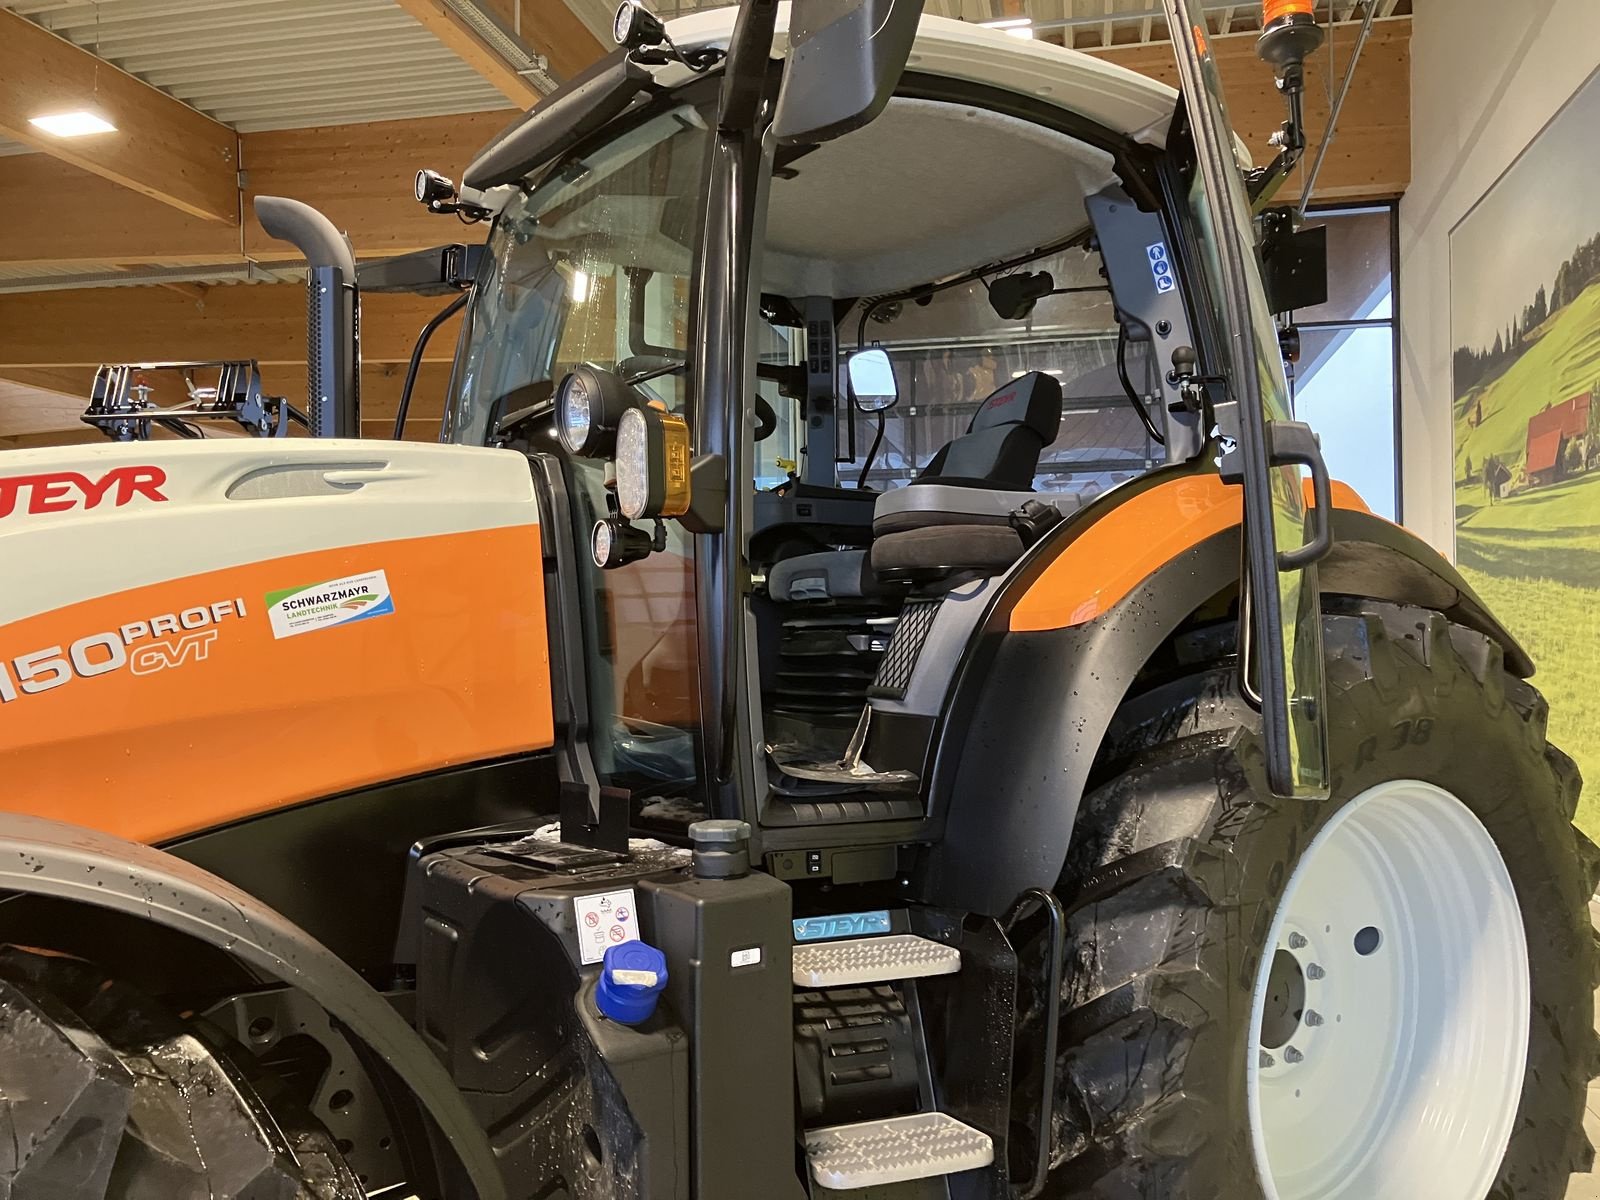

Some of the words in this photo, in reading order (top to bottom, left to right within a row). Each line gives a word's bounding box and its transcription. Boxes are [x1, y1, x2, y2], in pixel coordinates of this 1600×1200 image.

[282, 585, 369, 611] SCHWARZMAYR
[286, 602, 339, 619] LANDTECHNIK
[119, 597, 247, 646] PROFI
[130, 628, 218, 675] CVT
[1388, 716, 1436, 752] 38
[802, 915, 880, 937] STEYR
